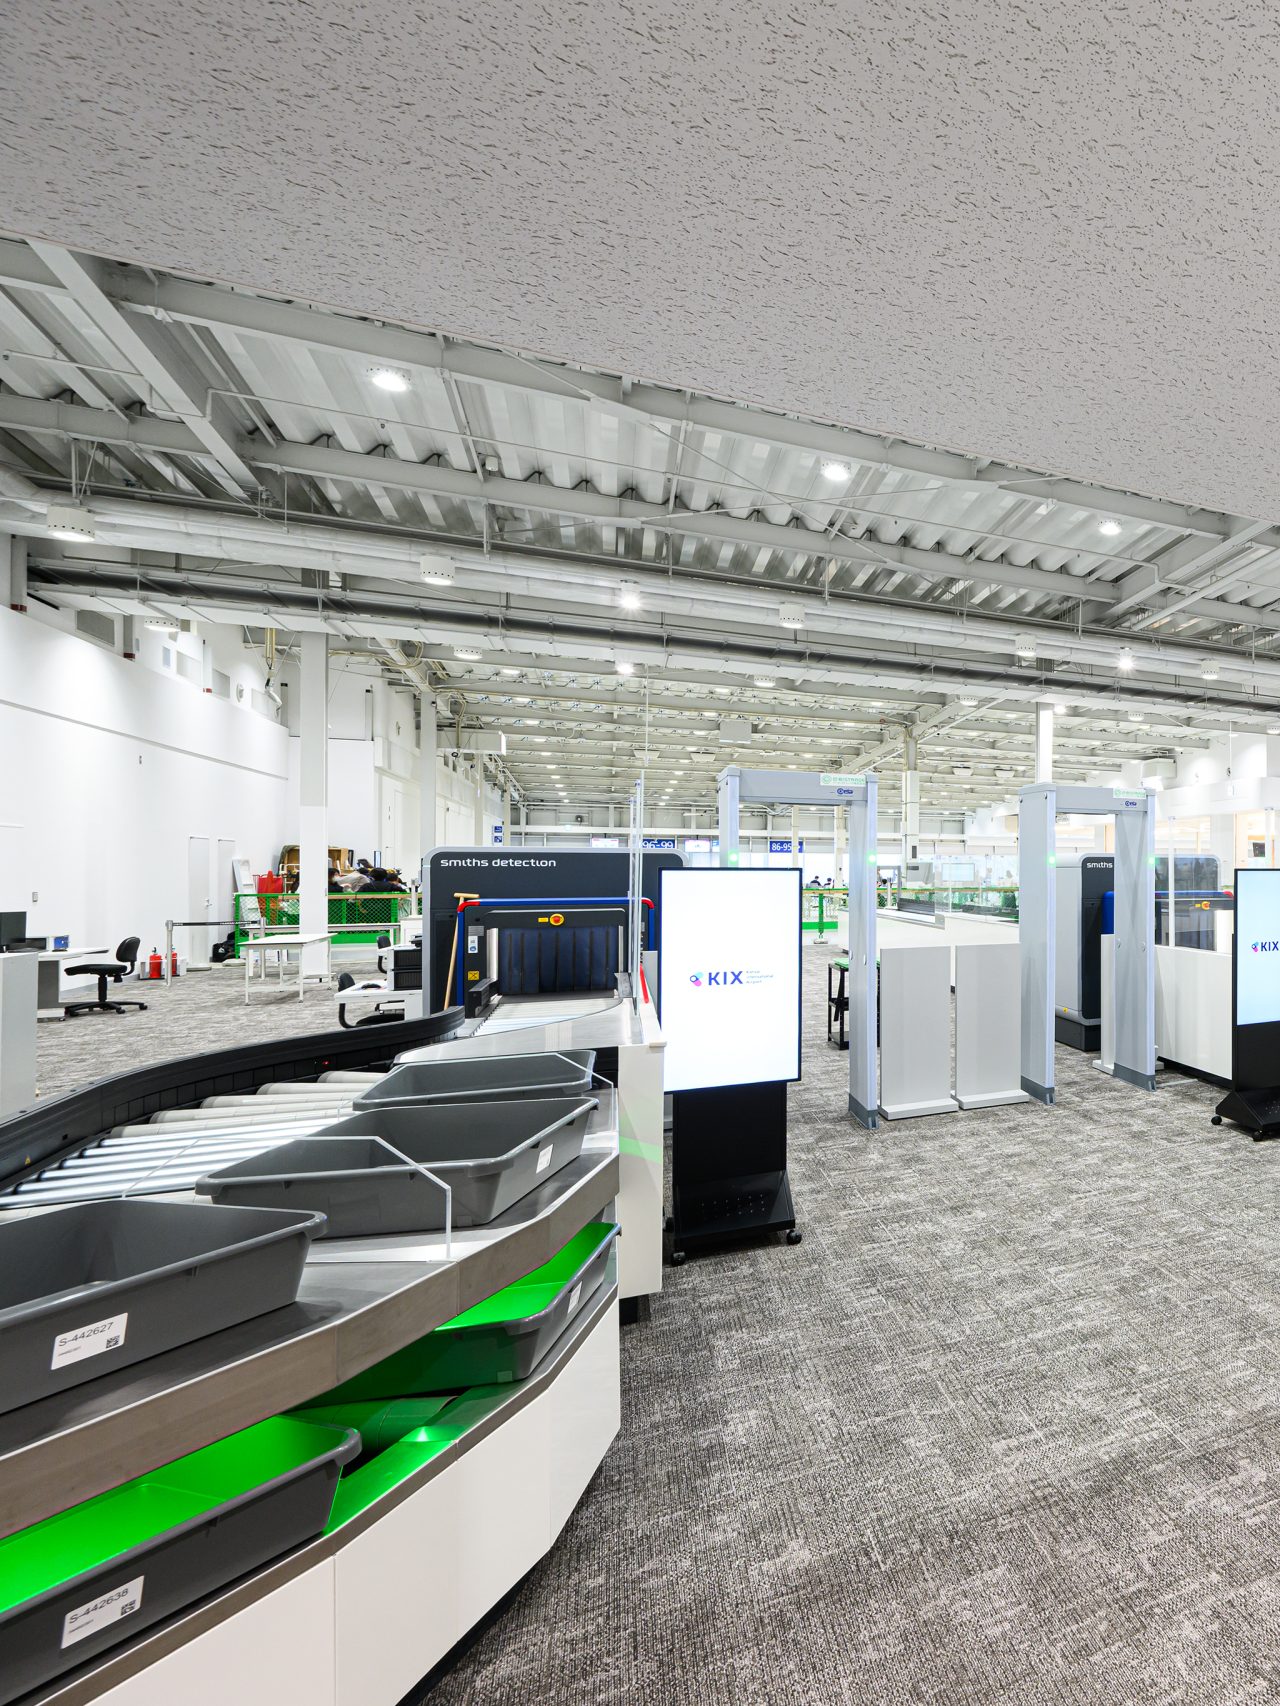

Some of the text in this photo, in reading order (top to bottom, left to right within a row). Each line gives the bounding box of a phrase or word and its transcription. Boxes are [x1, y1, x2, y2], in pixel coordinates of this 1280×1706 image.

[771, 842, 792, 851] 86-95
[440, 858, 557, 867] smiths detection
[1086, 861, 1113, 869] smiths
[1261, 941, 1279, 951] KIX
[708, 971, 743, 986] KIX
[58, 1322, 114, 1346] S-442627
[69, 1588, 128, 1624] S-442638
